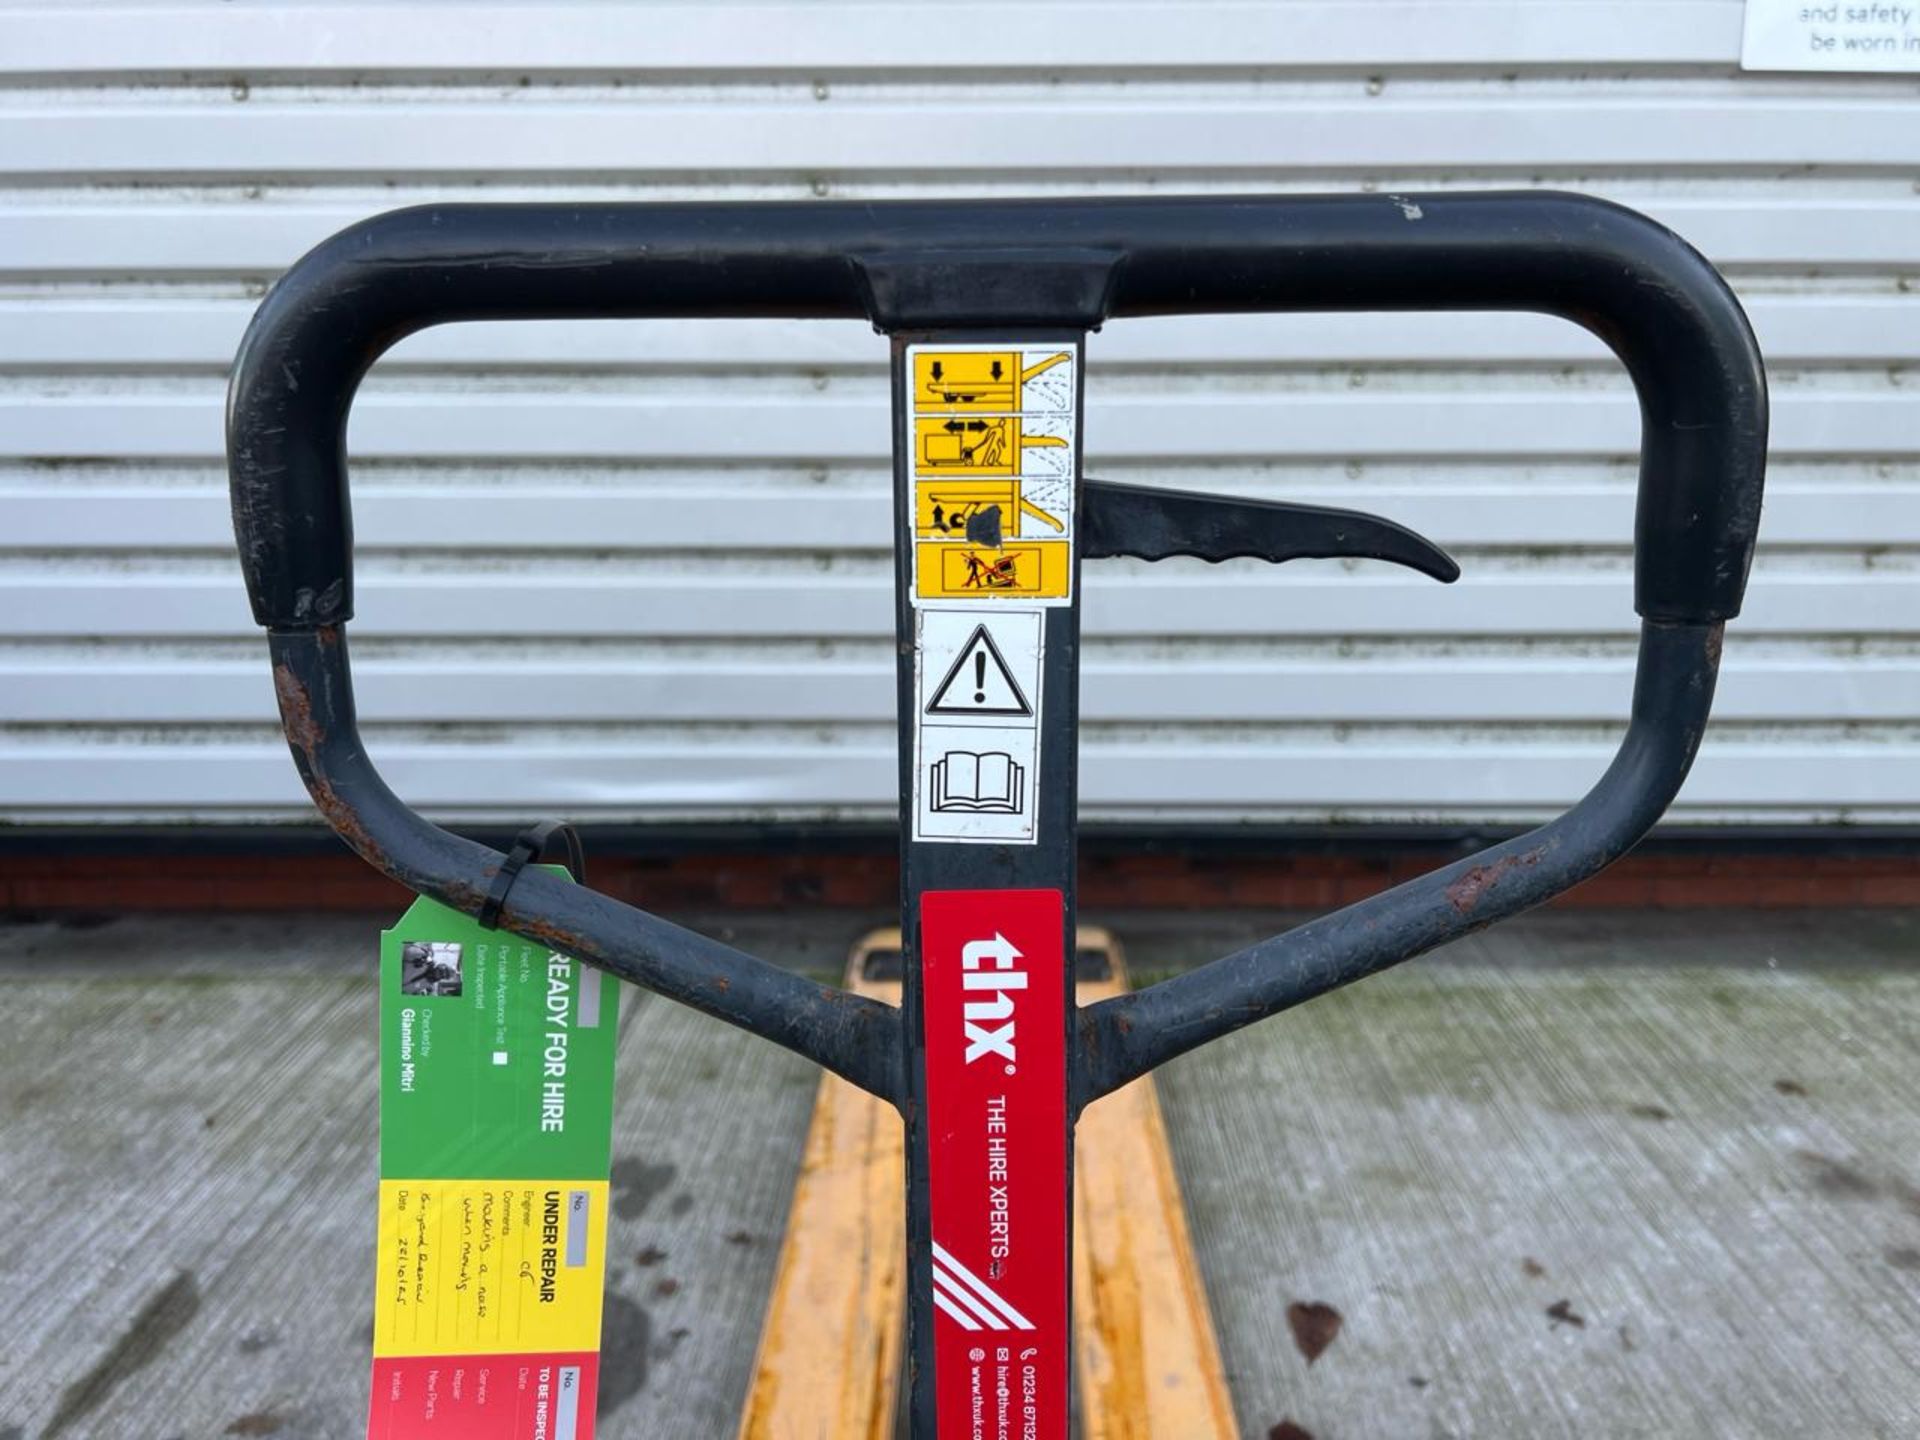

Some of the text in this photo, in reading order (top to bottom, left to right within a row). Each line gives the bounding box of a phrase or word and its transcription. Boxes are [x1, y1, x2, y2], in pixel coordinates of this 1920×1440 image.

[1800, 4, 1911, 26] and safety
[1810, 32, 1836, 51] be
[1844, 37, 1896, 51] worn
[474, 945, 488, 1009] Date Inspected
[499, 947, 509, 982] Portable
[496, 984, 507, 1024] Appliance
[962, 931, 1029, 1065] thx
[422, 1009, 432, 1046] Checked
[401, 1008, 416, 1092] Giannino Mitri
[544, 1033, 567, 1077] FOR
[542, 1083, 565, 1132] HIRE
[987, 1095, 1009, 1257] THE HIRE XPERTS
[399, 1191, 408, 1211] Date
[502, 1191, 513, 1236] Comments
[521, 1191, 534, 1227] Engineer
[540, 1191, 560, 1303] UNDER REPAIR
[478, 1263, 488, 1276] a
[391, 1371, 402, 1401] Initials
[452, 1369, 464, 1400] Repair
[478, 1368, 489, 1404] Service
[518, 1367, 529, 1390] Date
[537, 1384, 549, 1399] BE
[539, 1367, 550, 1382] TO
[563, 1371, 574, 1391] No.
[425, 1370, 440, 1420] New Parts
[1023, 1366, 1037, 1440] 01234 87132
